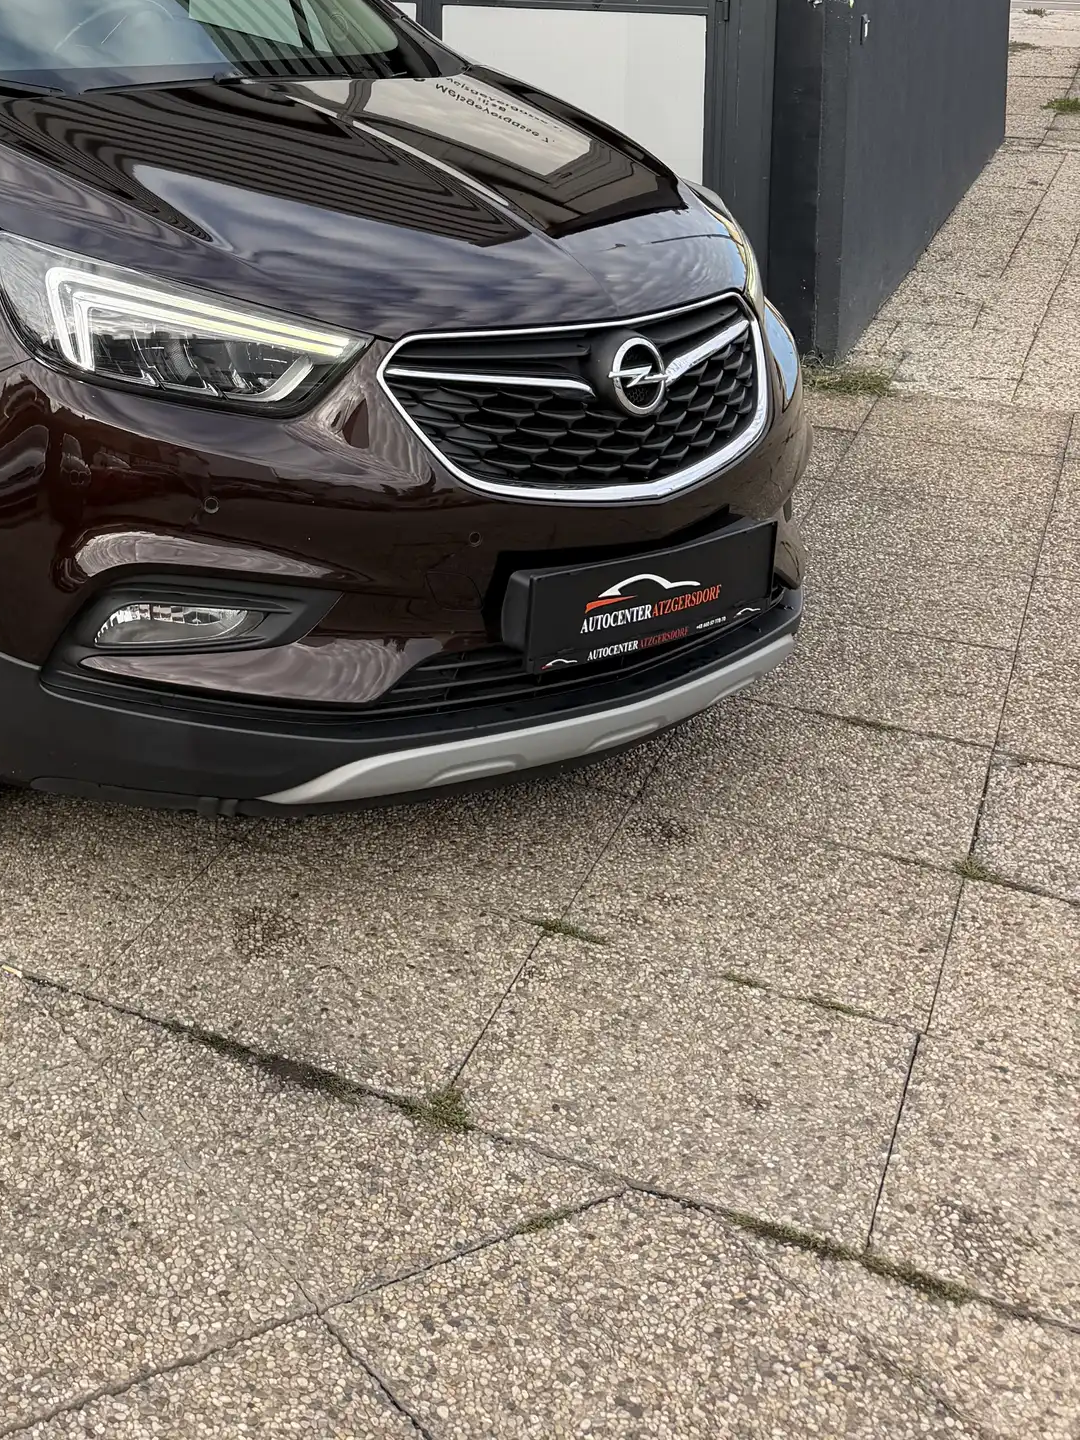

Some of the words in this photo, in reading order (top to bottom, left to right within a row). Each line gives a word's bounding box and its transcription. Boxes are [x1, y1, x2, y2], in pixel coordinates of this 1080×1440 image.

[580, 603, 652, 634] AUTOCENTER
[651, 584, 722, 617] ATZGERSDORF
[587, 639, 639, 662] AUTOCENTER
